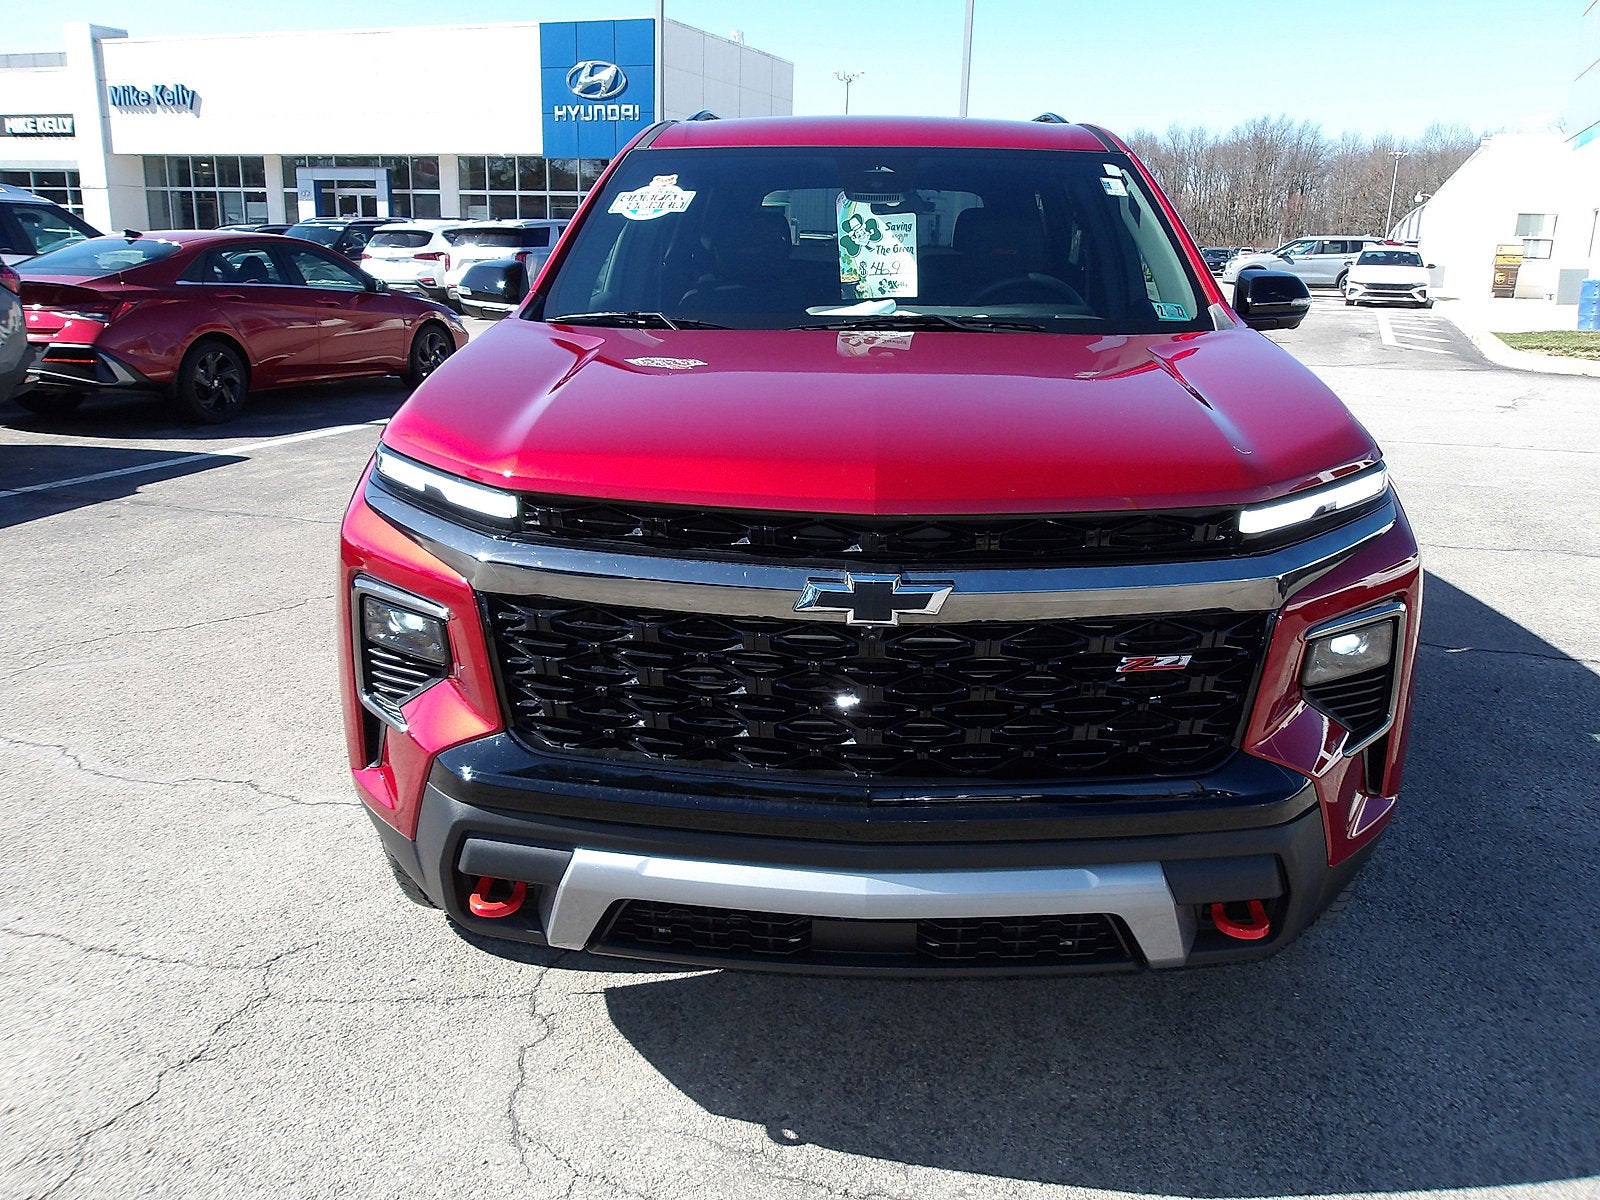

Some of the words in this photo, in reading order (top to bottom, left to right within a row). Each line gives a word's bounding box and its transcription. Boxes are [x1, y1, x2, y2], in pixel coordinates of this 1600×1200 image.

[109, 85, 150, 106] Mike
[152, 84, 196, 110] Kelly
[554, 104, 640, 121] HYUNDAI
[4, 116, 37, 134] MIKE
[36, 116, 74, 134] KELLY
[885, 221, 913, 232] Saving
[876, 244, 891, 256] The
[1115, 655, 1193, 673] Z71
